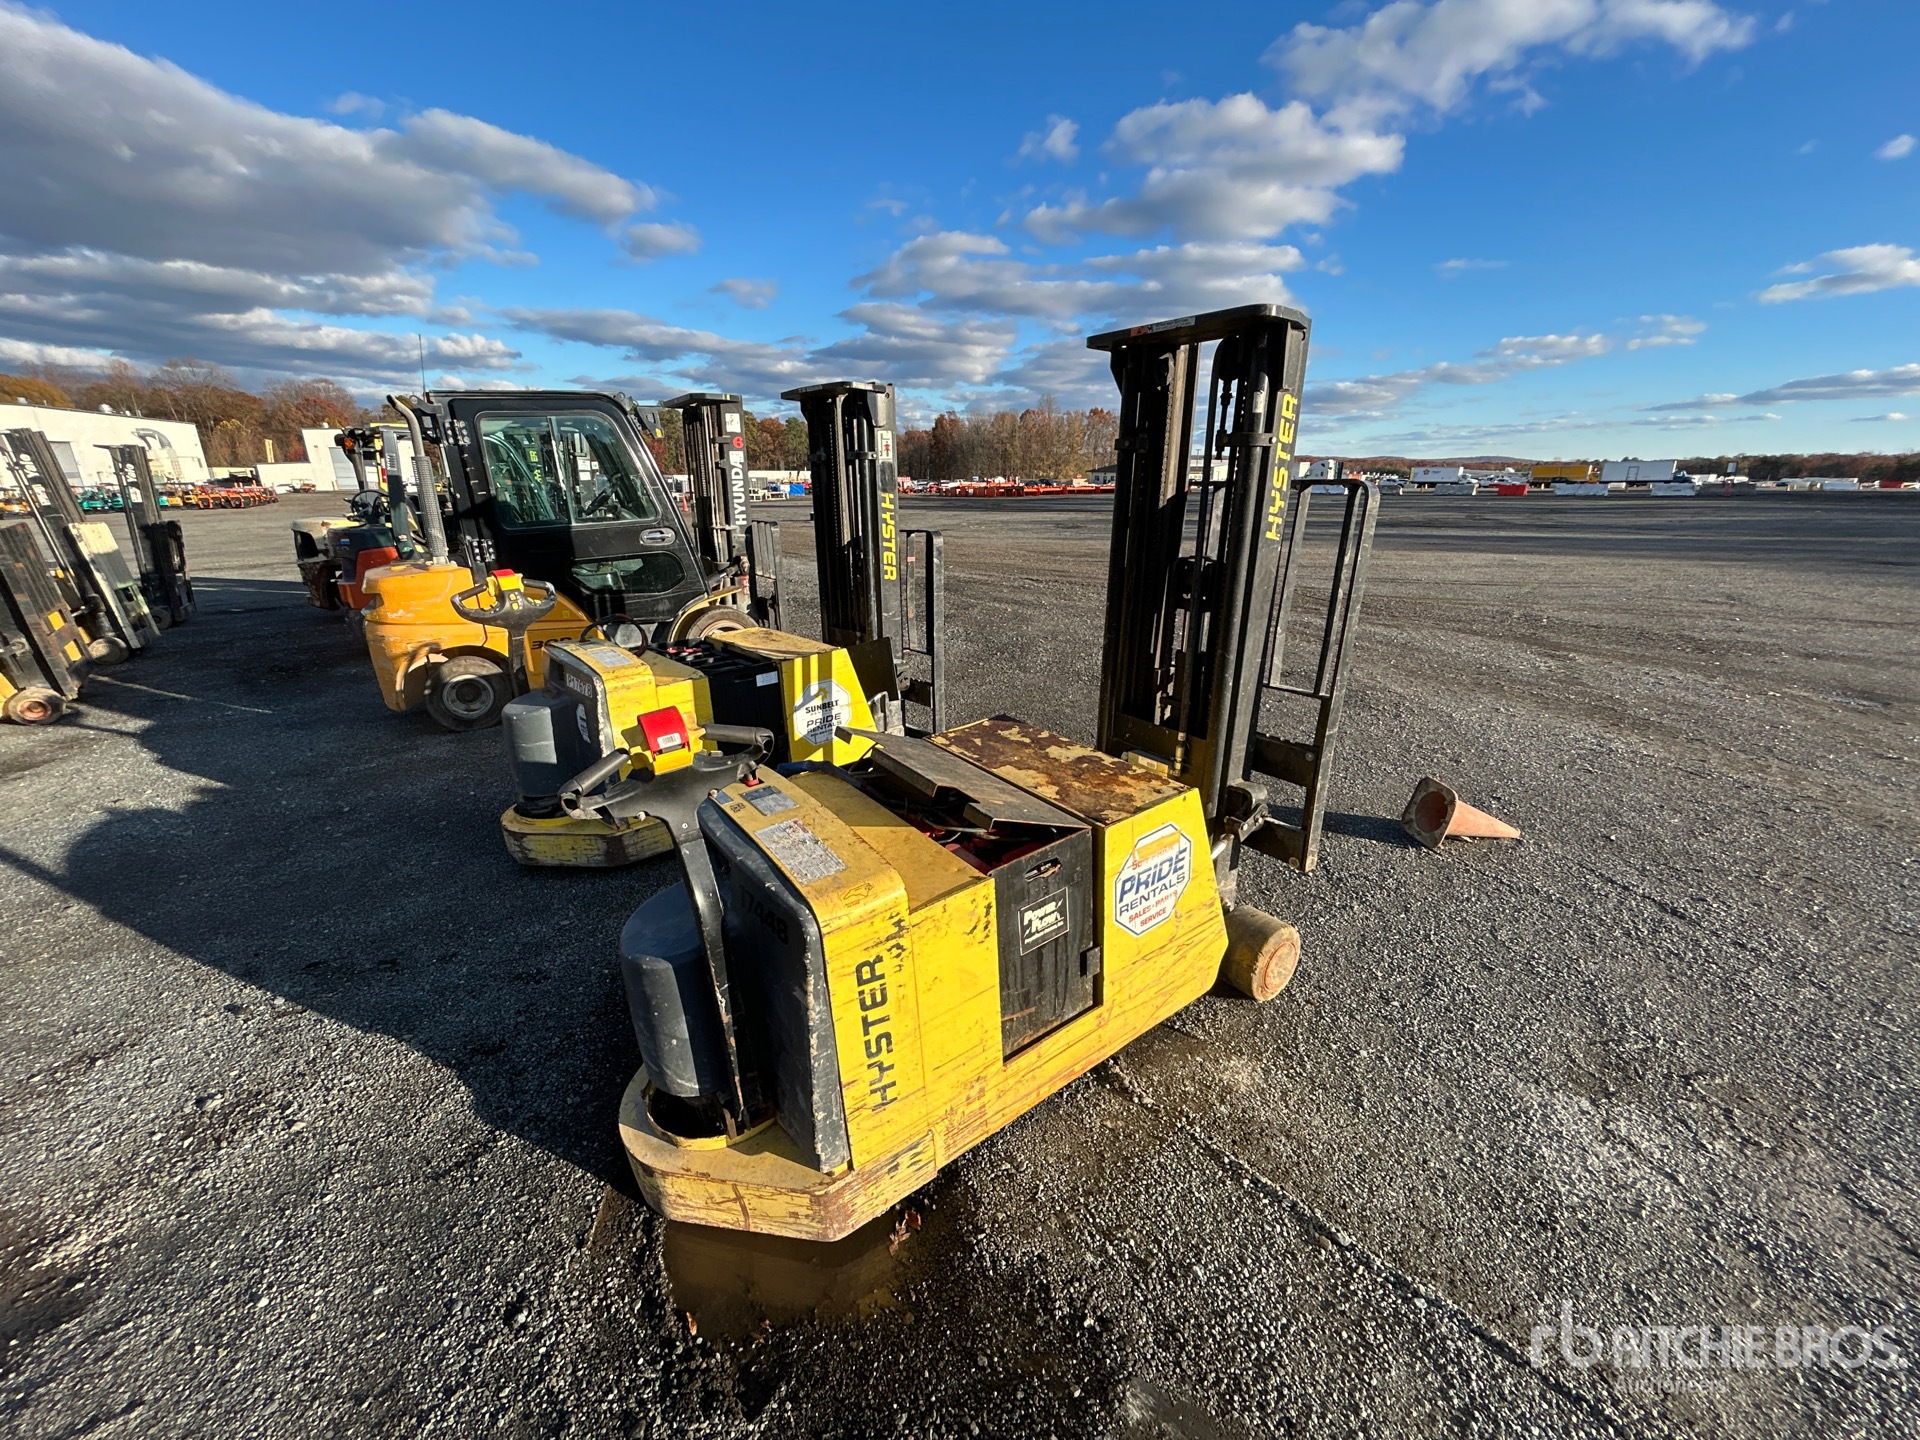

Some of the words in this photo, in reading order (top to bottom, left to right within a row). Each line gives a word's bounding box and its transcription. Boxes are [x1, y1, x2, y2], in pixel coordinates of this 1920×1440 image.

[1266, 393, 1298, 541] HYSTER
[729, 457, 747, 525] HYUNDA
[881, 492, 897, 581] HYSTER
[805, 700, 839, 714] SUNBELT
[807, 712, 842, 728] PRIDE
[807, 720, 842, 734] RENTALS
[1119, 847, 1188, 904] PRIDE
[1119, 871, 1186, 917] RENTALS
[1129, 904, 1152, 923] SALES
[1155, 889, 1178, 908] PARTS
[1140, 907, 1167, 927] SERVICE
[855, 954, 898, 1112] HYSTER
